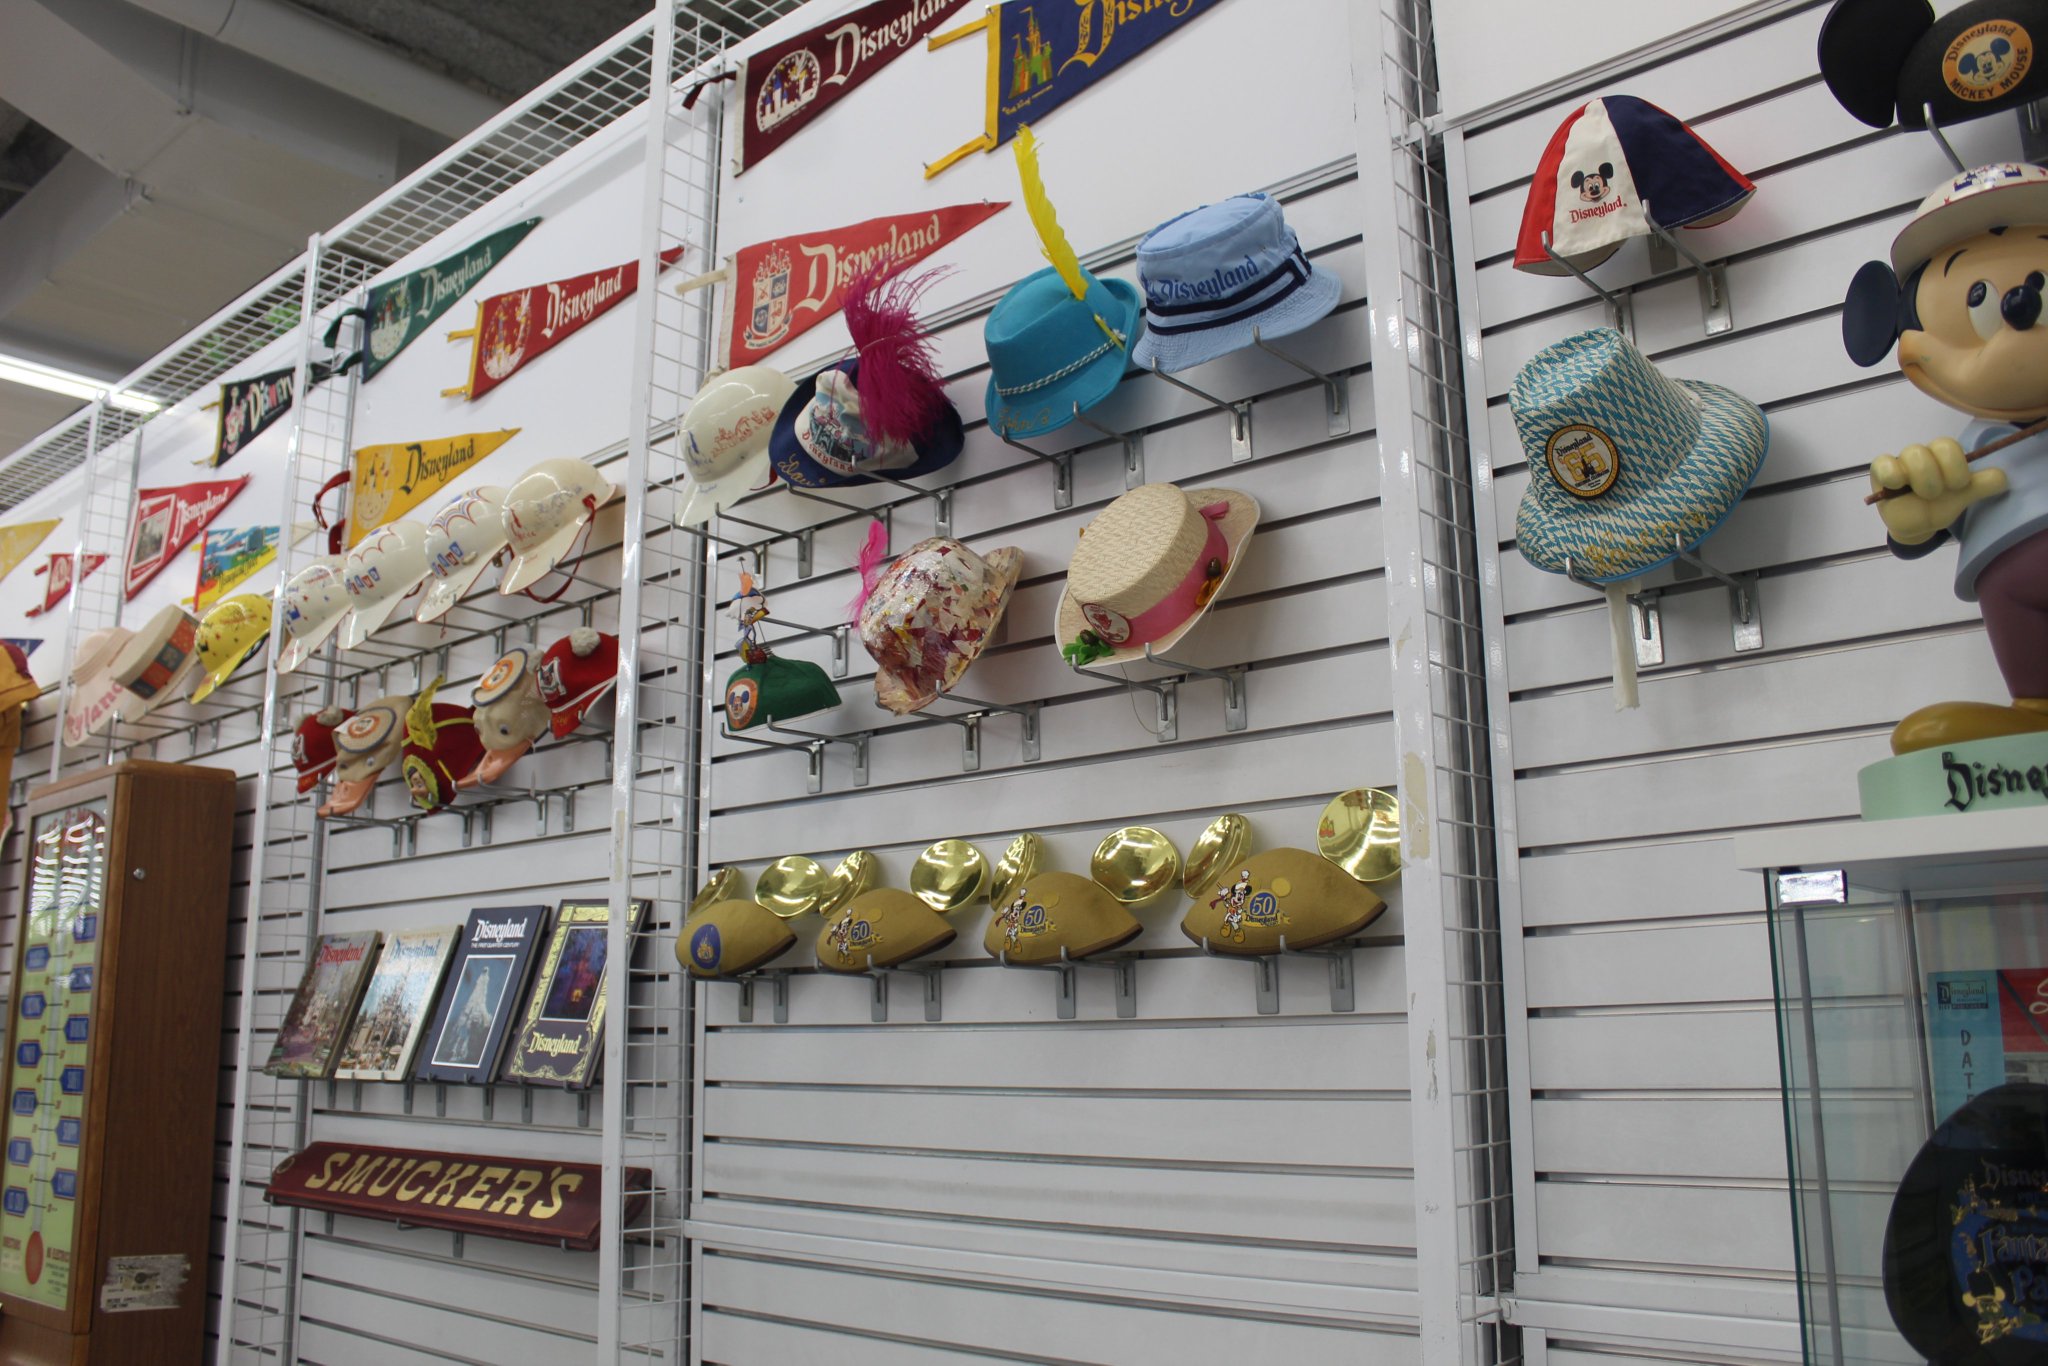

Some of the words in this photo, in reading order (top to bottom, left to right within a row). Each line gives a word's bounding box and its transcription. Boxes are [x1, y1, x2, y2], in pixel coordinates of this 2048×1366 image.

[821, 0, 951, 87] Disneylan
[1945, 23, 2017, 62] Disneyland
[1950, 77, 1994, 99] MICKEY
[1999, 46, 2028, 90] MOUSE
[415, 246, 492, 318] Disneyland
[793, 213, 941, 312] Disneyland
[1158, 254, 1260, 300] Disneyland
[541, 266, 623, 339] Disneyland
[248, 375, 294, 433] DISNEY
[398, 437, 475, 496] Disneyland
[802, 430, 855, 473] Dsneyland
[170, 487, 228, 548] Disneyland
[471, 917, 528, 943] Disneyland
[852, 922, 869, 941] 50
[1025, 908, 1043, 926] 50
[1251, 896, 1274, 915] 50
[527, 1031, 582, 1058] Disneyland
[304, 1152, 584, 1220] SMUCKER'S
